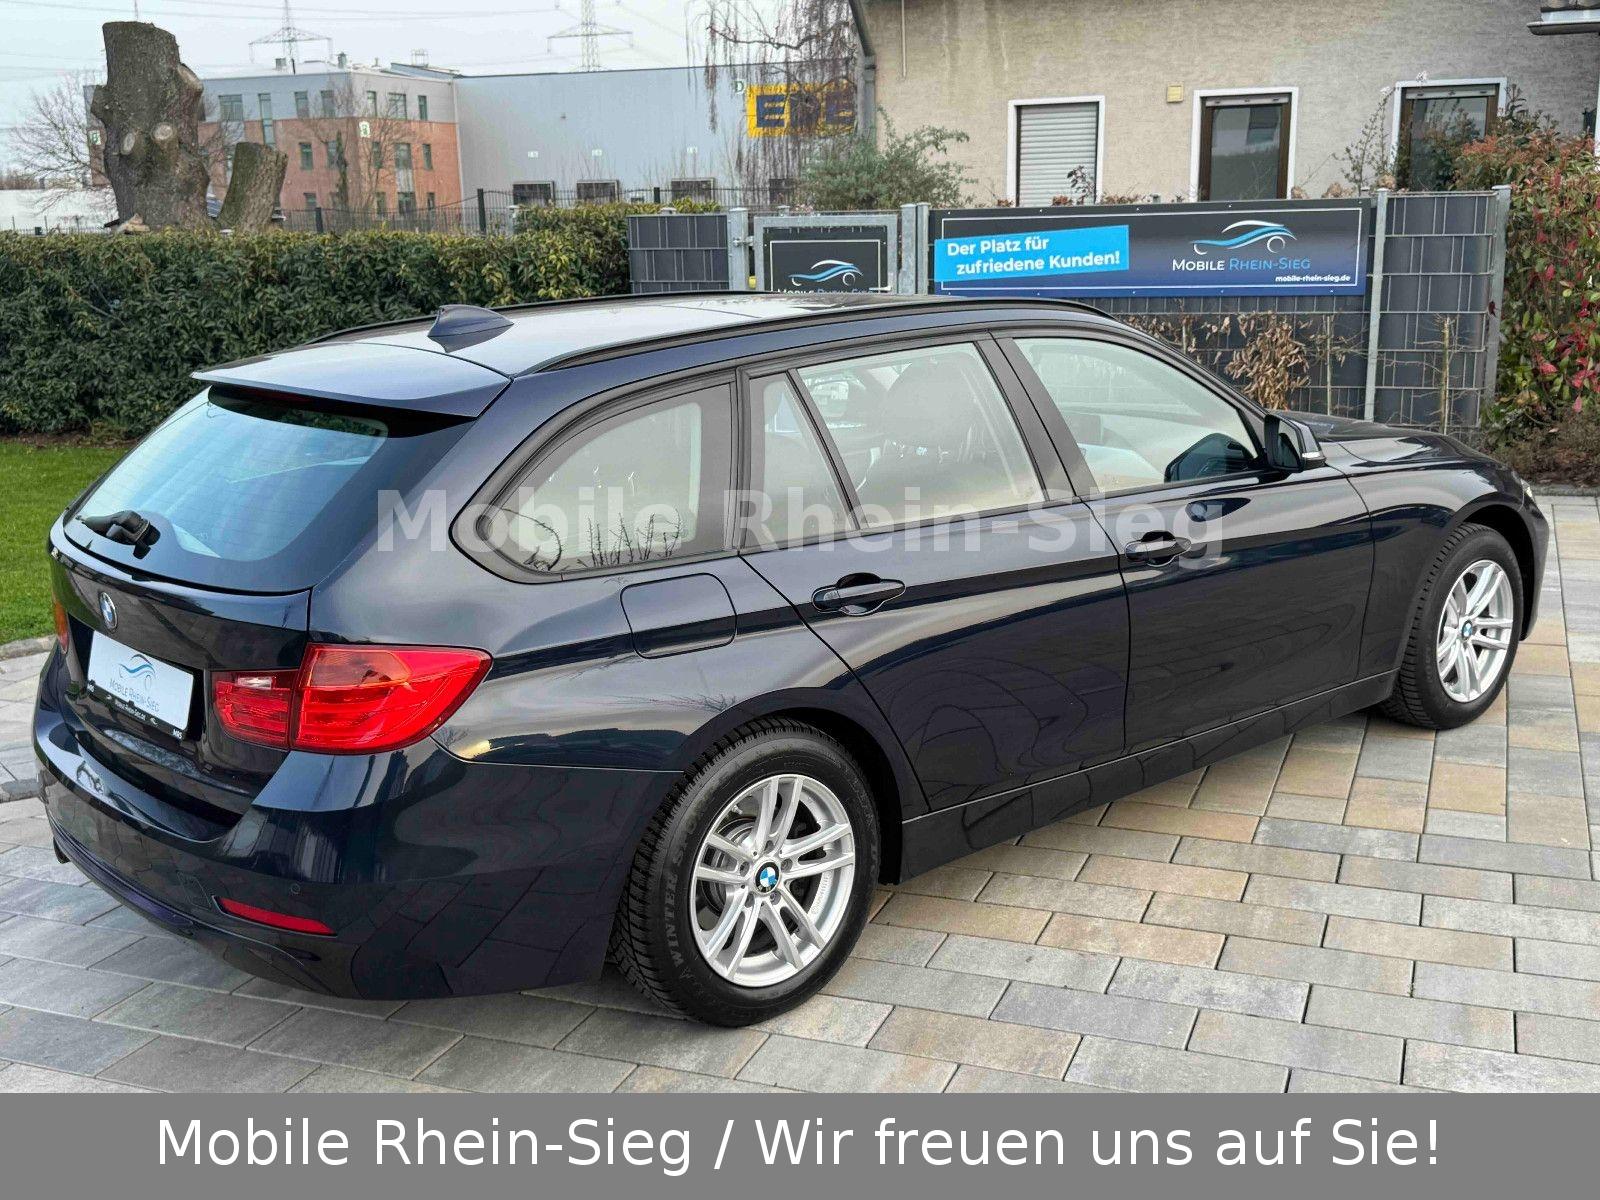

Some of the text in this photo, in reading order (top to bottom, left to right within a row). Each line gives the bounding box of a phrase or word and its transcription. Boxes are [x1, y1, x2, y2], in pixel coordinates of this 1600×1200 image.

[947, 236, 1050, 256] Der Platz für
[956, 250, 1120, 276] zufriedene Kunden!
[1275, 273, 1351, 283] mobile-rhein-sieg.de
[664, 872, 685, 969] WINTER
